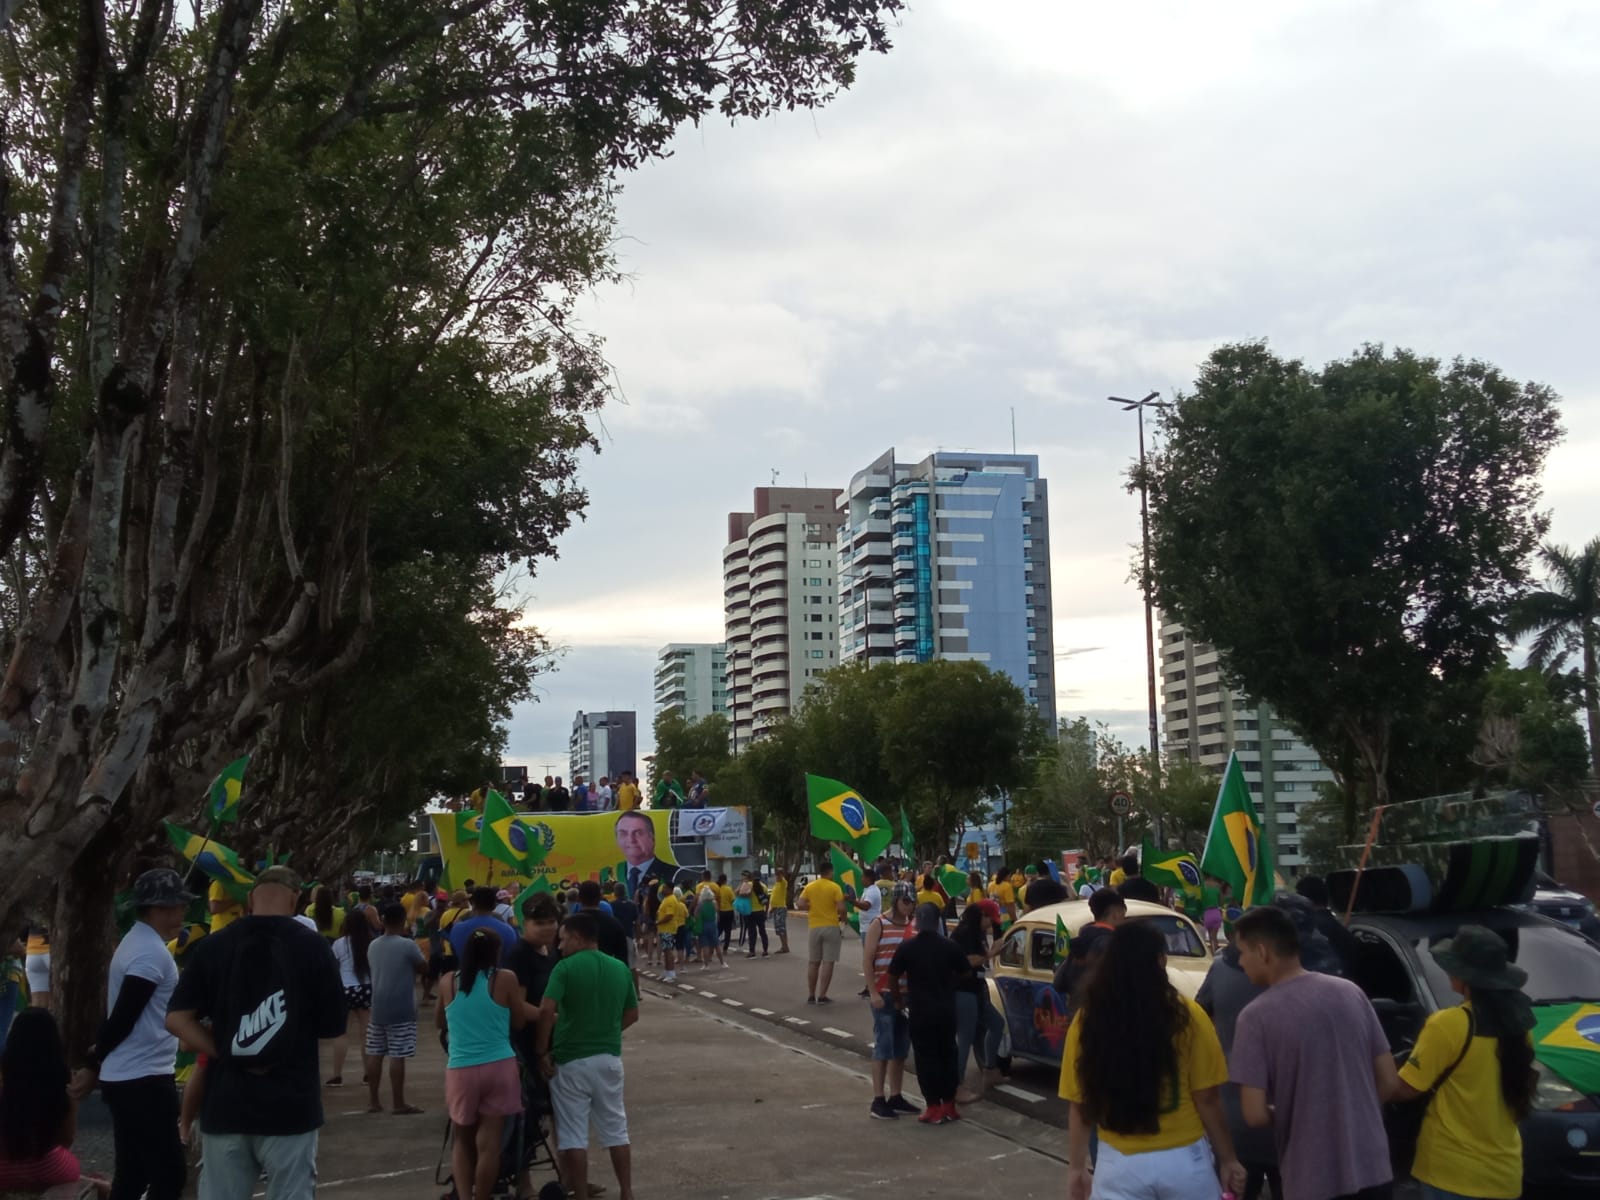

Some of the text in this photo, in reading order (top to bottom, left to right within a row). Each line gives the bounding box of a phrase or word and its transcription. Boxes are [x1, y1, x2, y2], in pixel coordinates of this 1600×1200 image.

[1113, 798, 1128, 807] 40
[501, 867, 557, 876] AMAONAS
[238, 989, 287, 1042] NIKE
